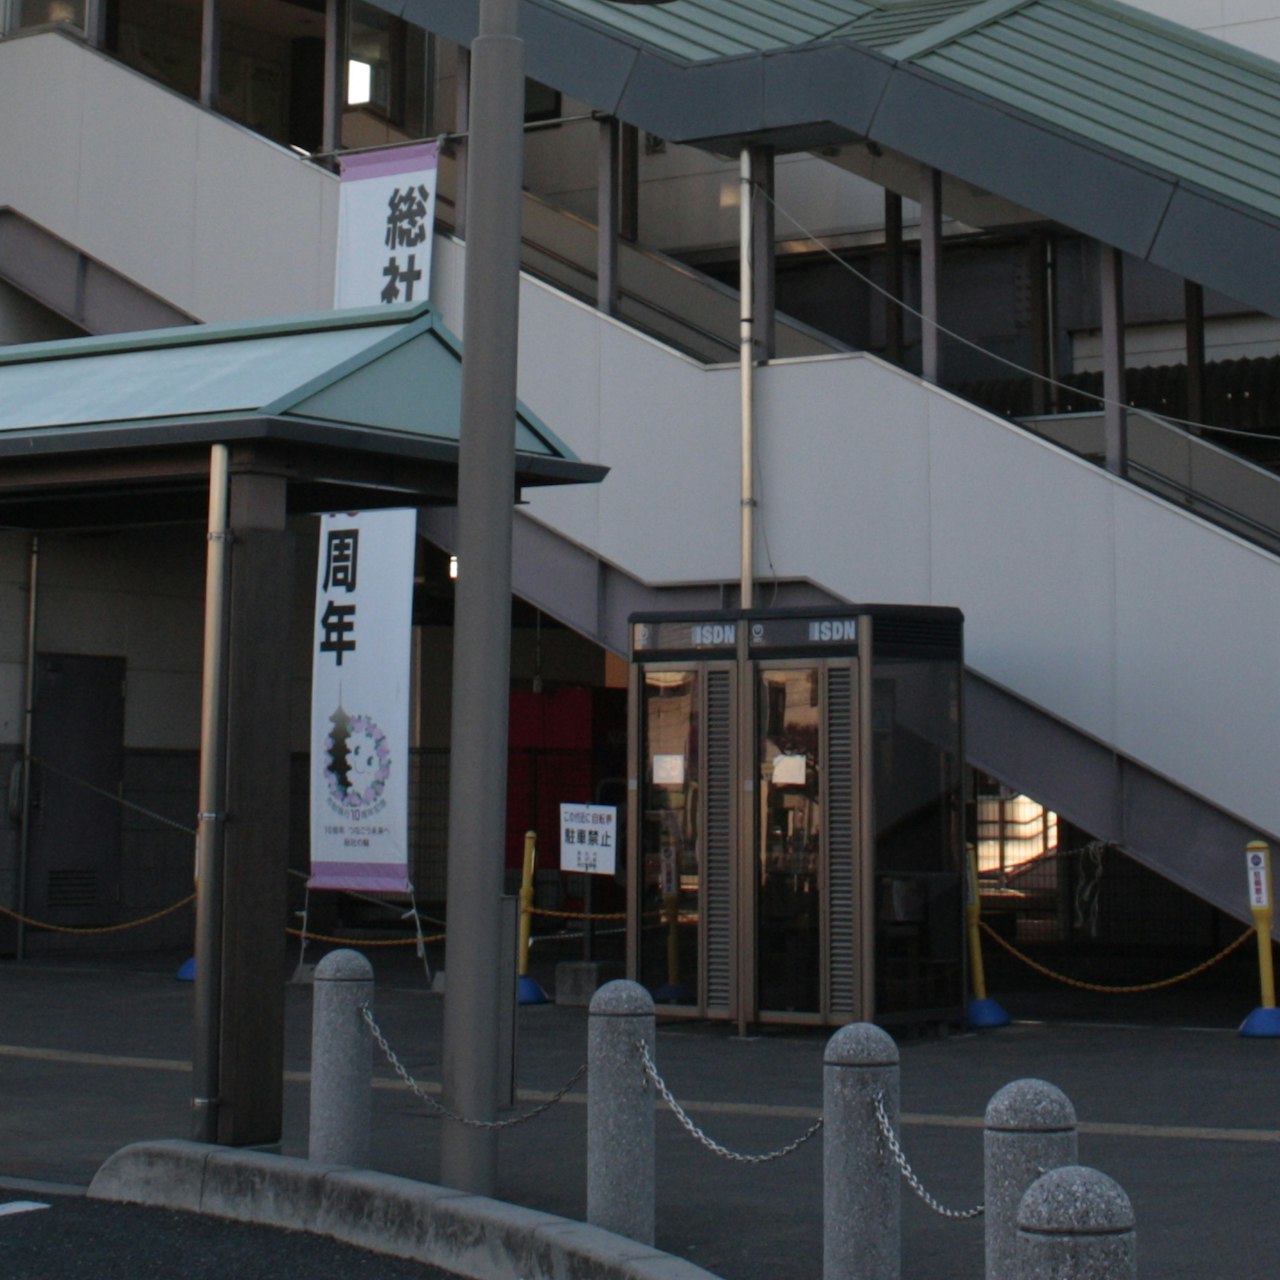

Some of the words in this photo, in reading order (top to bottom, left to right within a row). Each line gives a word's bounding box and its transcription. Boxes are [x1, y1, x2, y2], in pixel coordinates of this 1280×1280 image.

[381, 184, 430, 303] 総社
[320, 529, 360, 666] 周年
[810, 621, 856, 641] ISDN
[693, 624, 736, 645] ISDN
